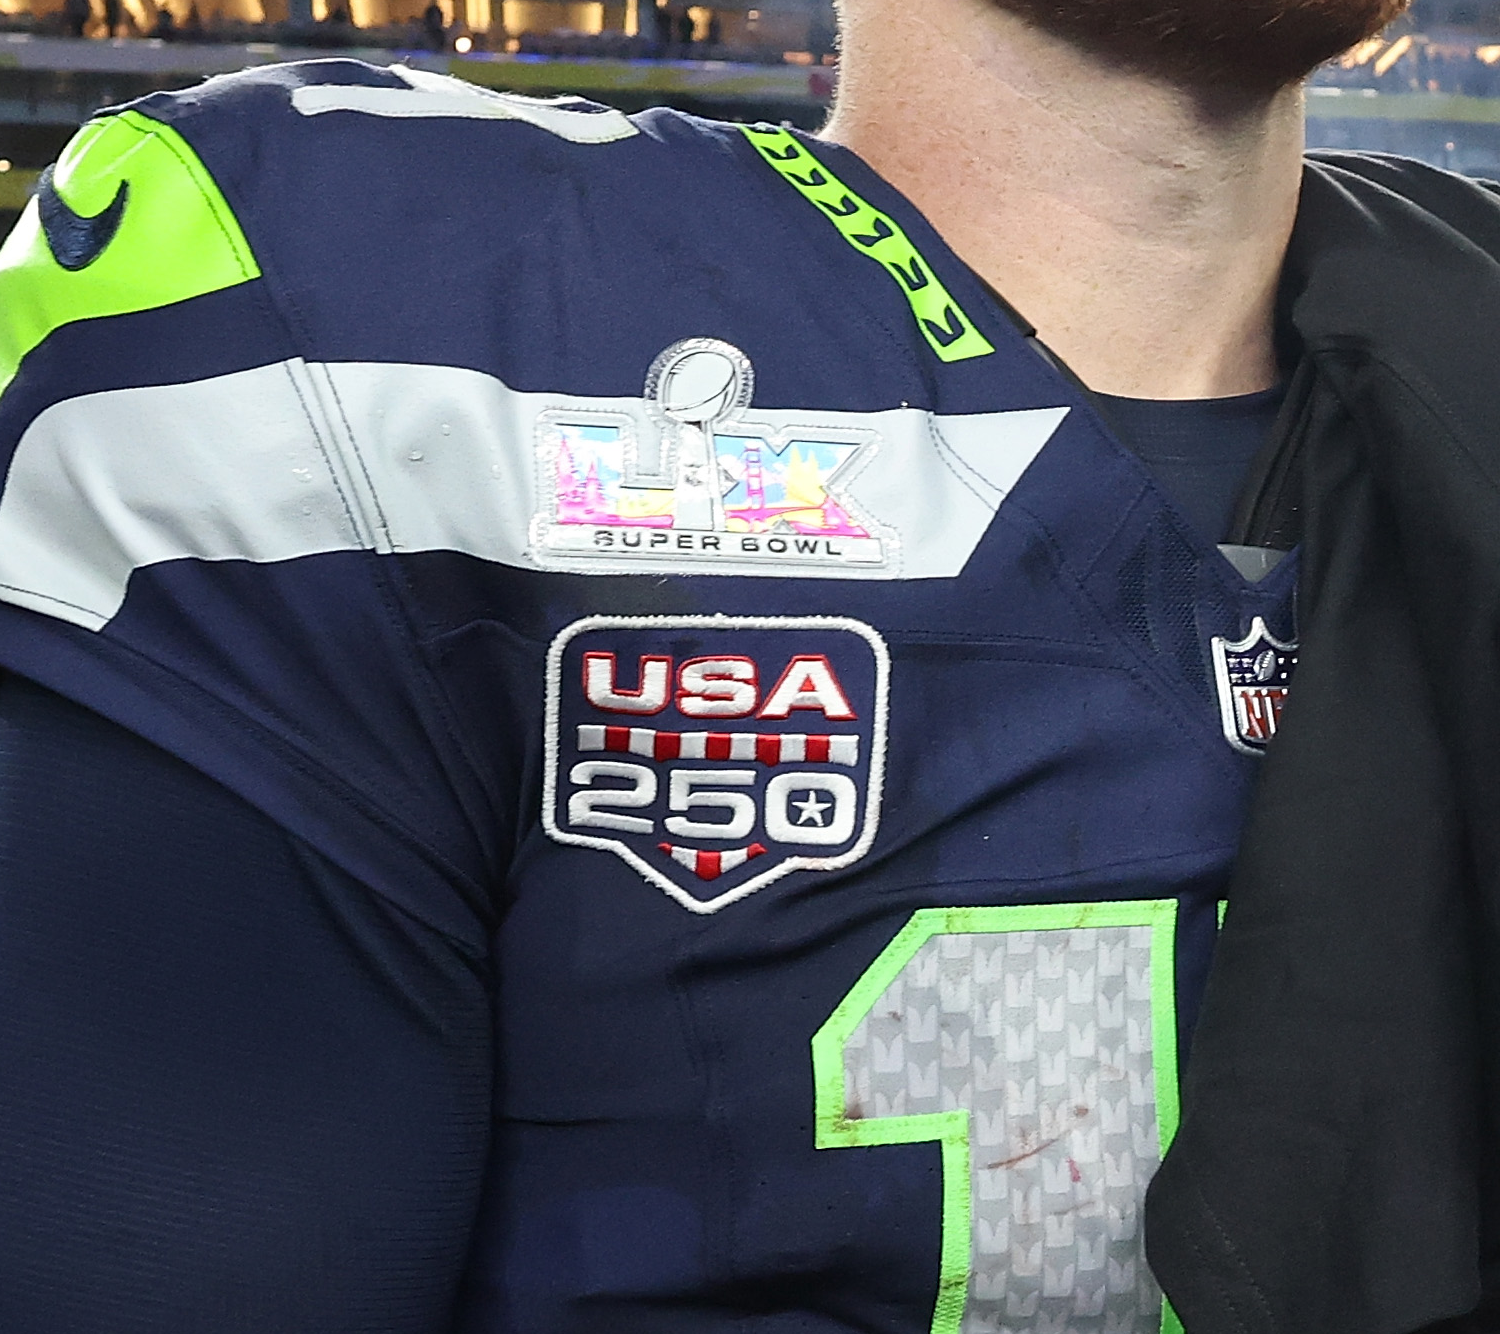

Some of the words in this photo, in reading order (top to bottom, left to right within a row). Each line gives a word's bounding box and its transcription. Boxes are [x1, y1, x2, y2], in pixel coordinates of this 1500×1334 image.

[593, 530, 721, 551] SUPER
[741, 537, 842, 556] BOWL
[582, 651, 858, 720] USA
[568, 760, 858, 845] 250
